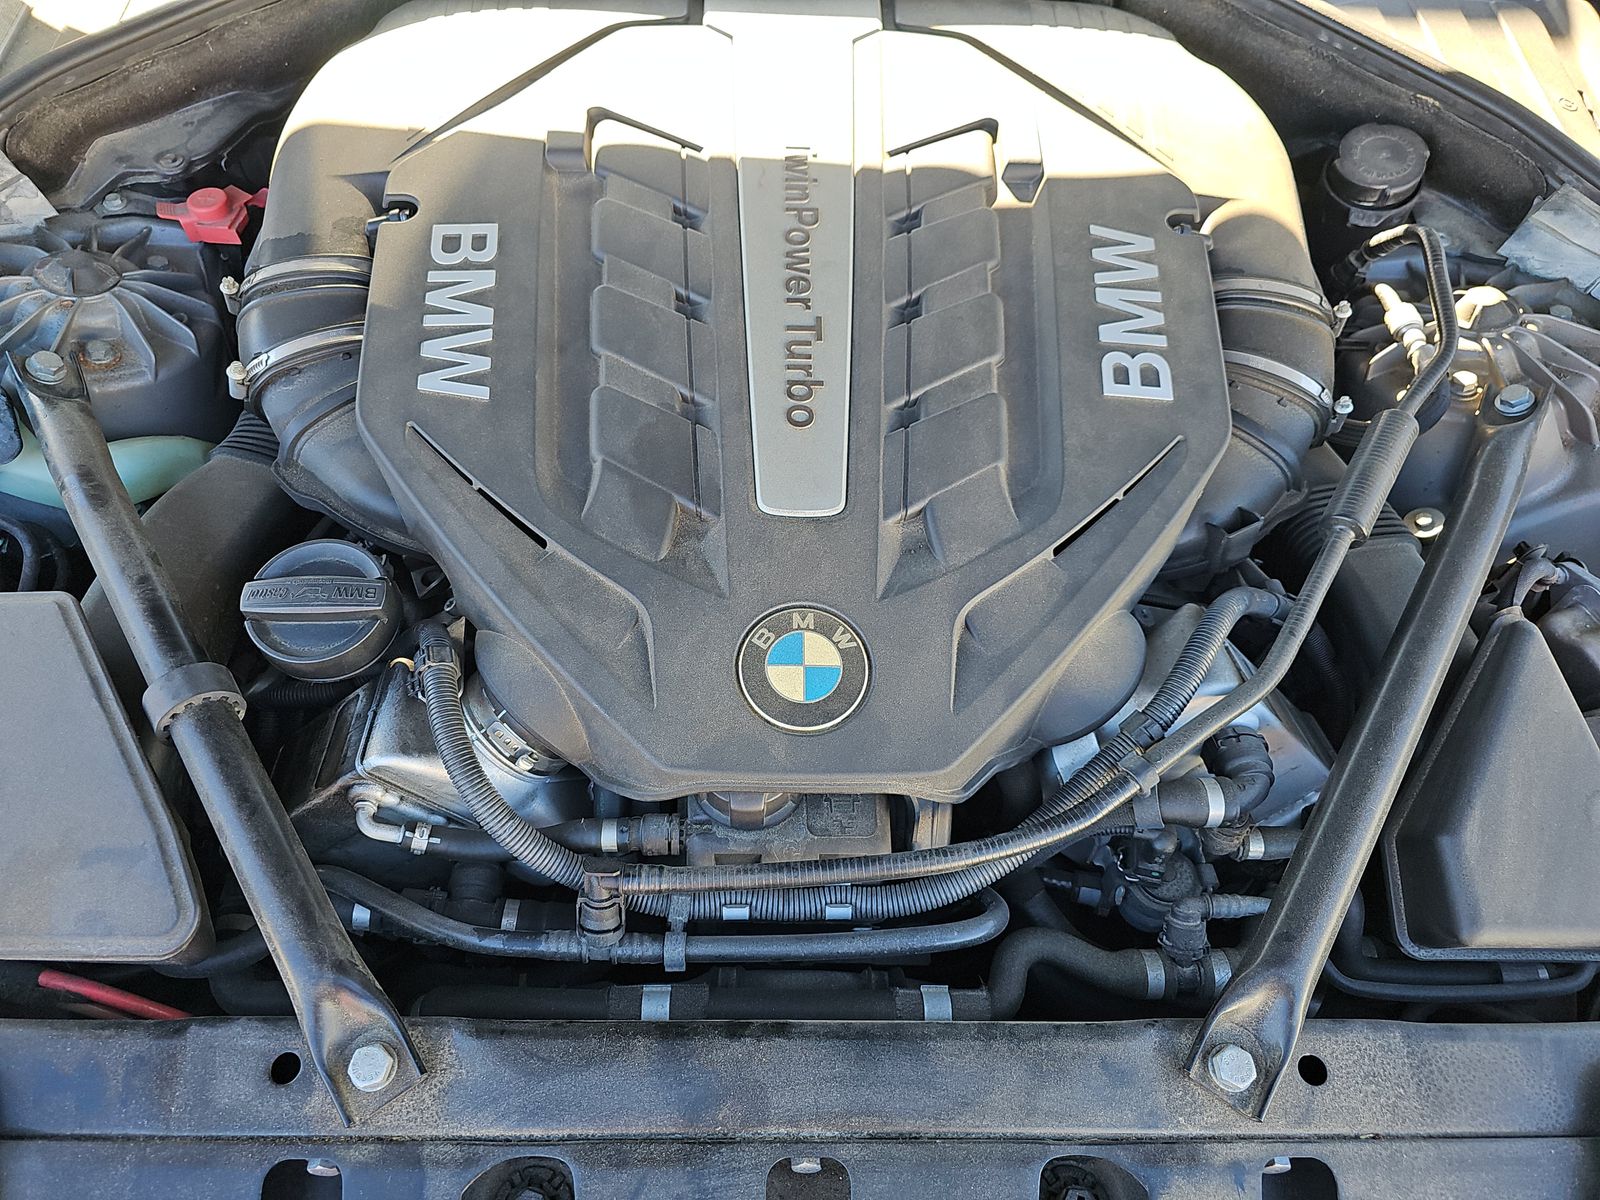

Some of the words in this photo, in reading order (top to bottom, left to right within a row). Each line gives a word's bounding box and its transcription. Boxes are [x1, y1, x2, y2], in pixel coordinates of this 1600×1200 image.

[417, 223, 499, 400] BMW
[1089, 224, 1174, 401] BMW
[784, 316, 826, 430] Turbo
[332, 586, 378, 600] BMW
[751, 612, 858, 650] BMW
